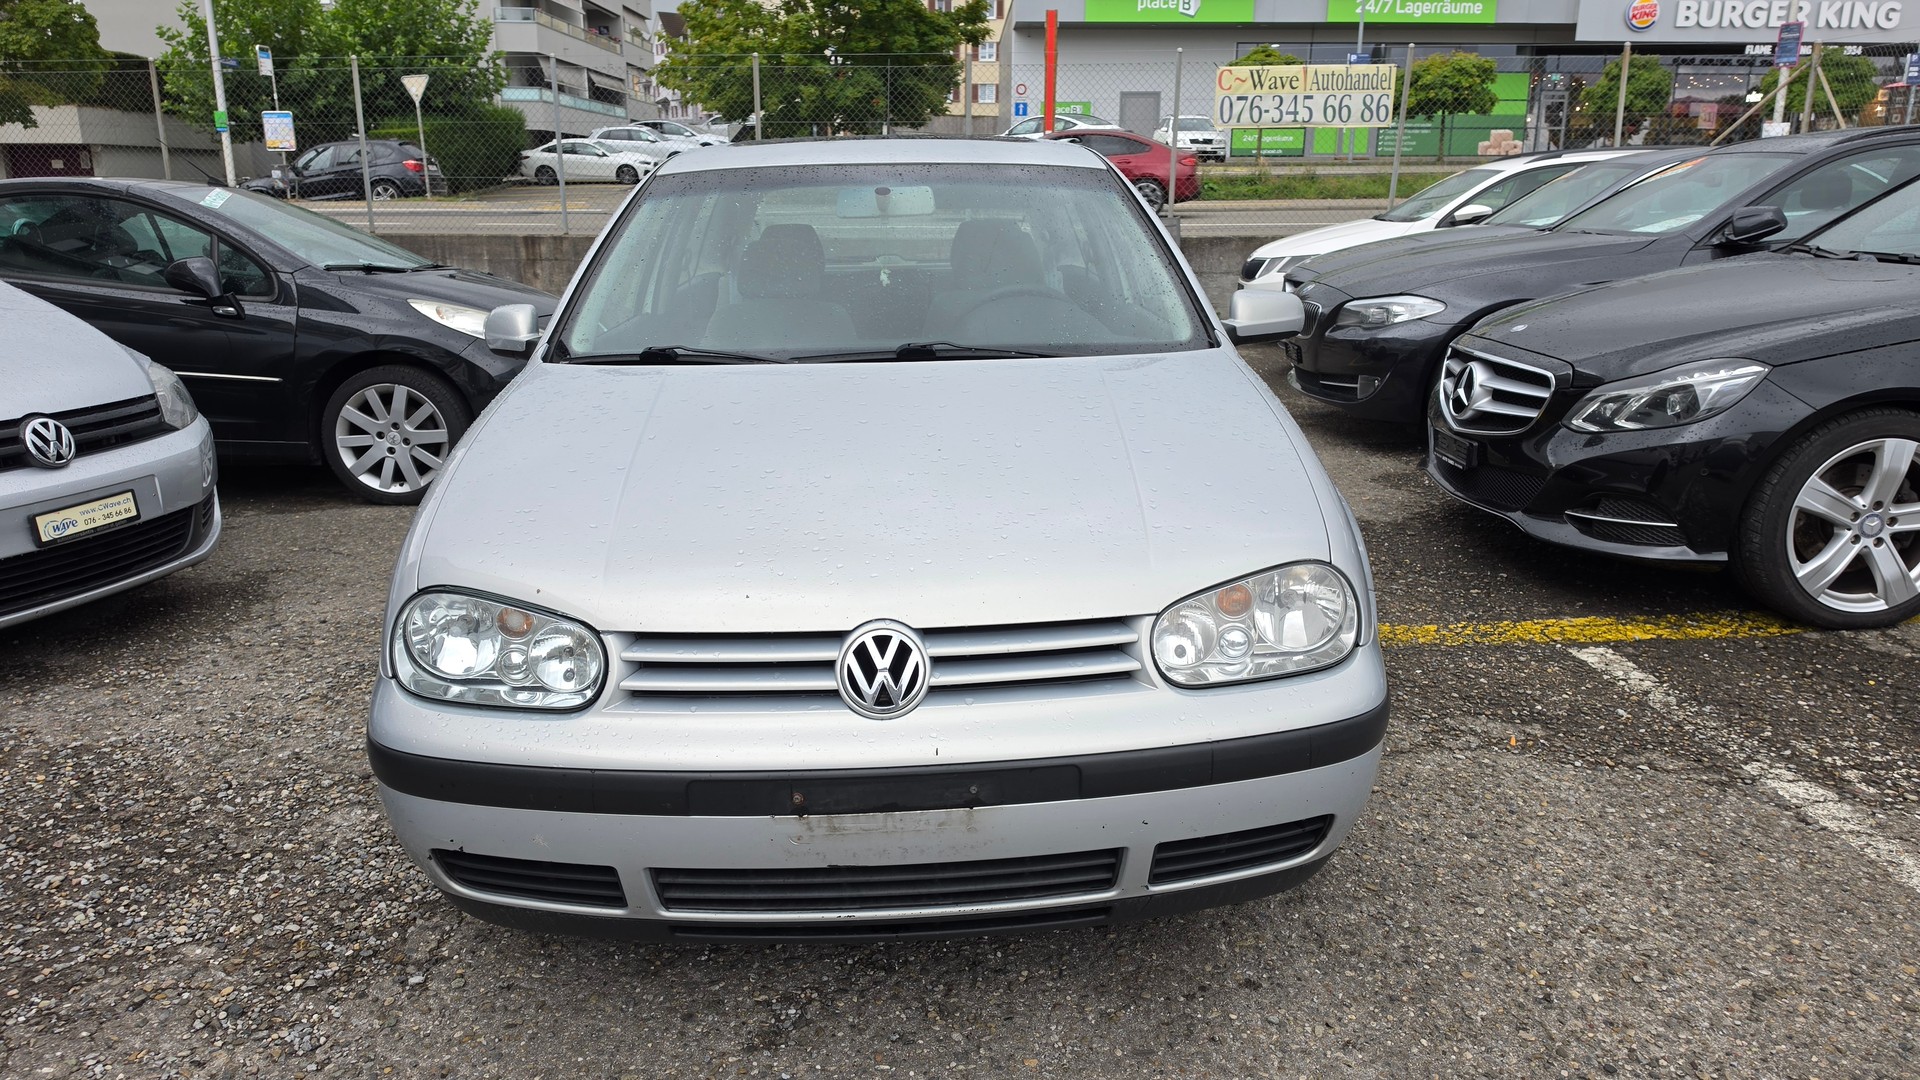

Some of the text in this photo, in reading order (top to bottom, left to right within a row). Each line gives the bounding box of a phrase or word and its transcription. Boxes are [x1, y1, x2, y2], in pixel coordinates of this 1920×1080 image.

[1355, 0, 1483, 17] 24/7 Lagerräume
[1631, 4, 1657, 12] BURGER
[1631, 10, 1657, 20] KING
[1675, 0, 1903, 29] BURGER KING
[1309, 65, 1392, 91] Autohandel
[1219, 94, 1389, 124] 076-345 66 86
[84, 517, 97, 526] 076
[102, 511, 114, 521] 345
[115, 509, 123, 517] 66
[124, 506, 132, 514] 86
